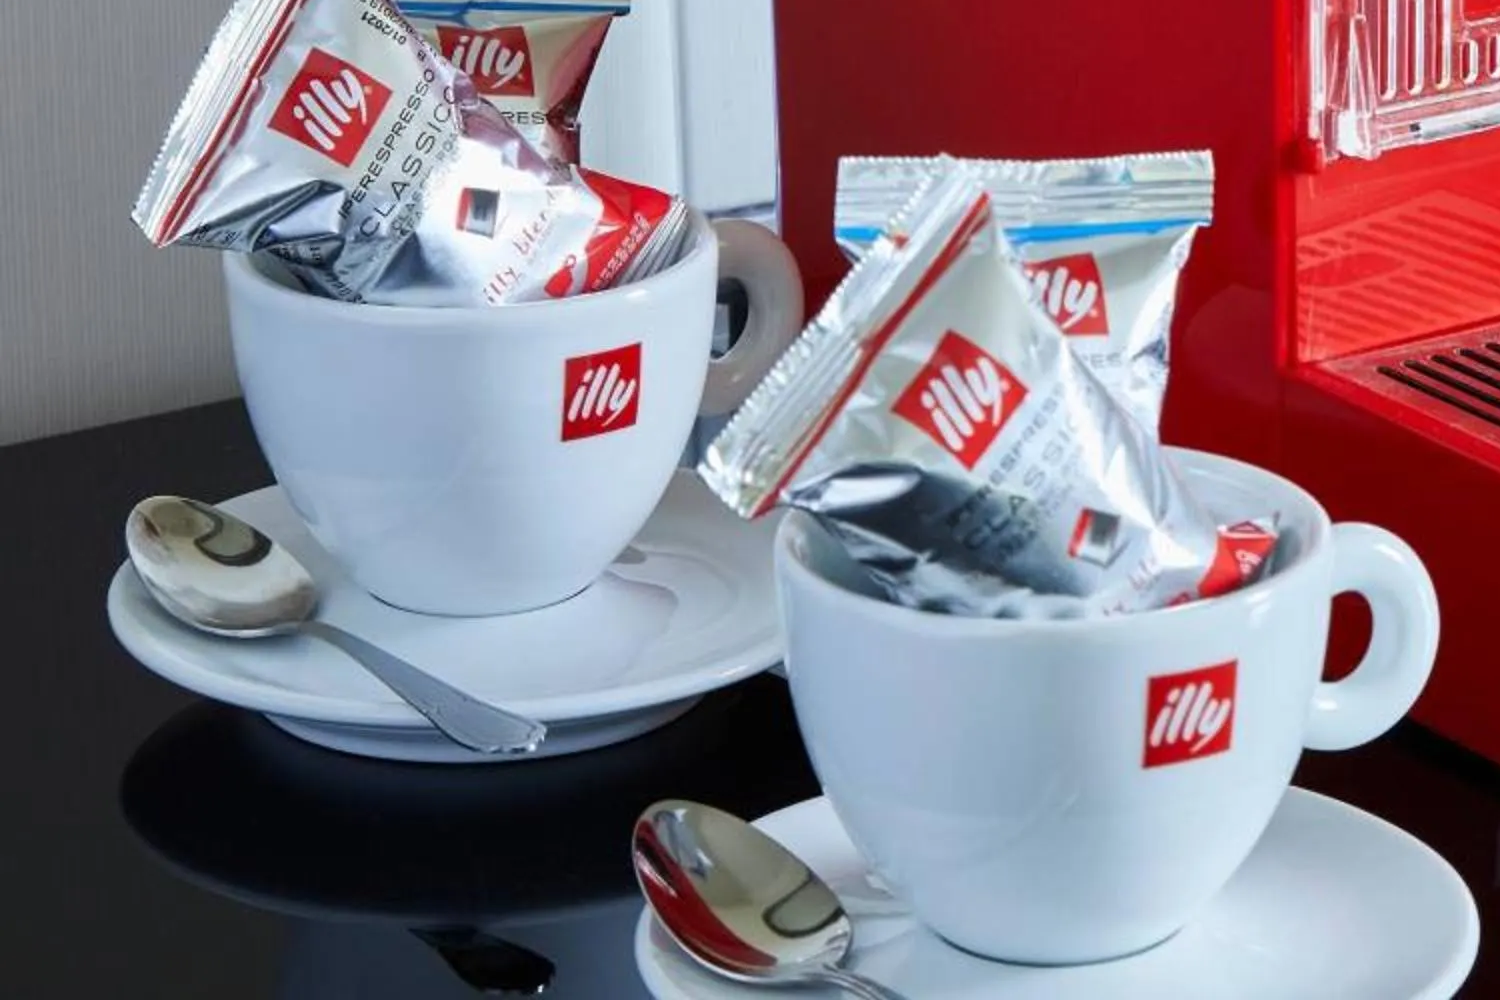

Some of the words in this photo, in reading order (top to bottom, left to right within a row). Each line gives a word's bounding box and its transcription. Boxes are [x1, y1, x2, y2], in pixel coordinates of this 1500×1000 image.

[450, 35, 525, 89] illy
[293, 69, 367, 151] illy
[338, 68, 435, 220] IPERESPRESSO
[567, 363, 636, 427] illy
[921, 357, 1002, 452] illy
[1150, 681, 1231, 754] illy
